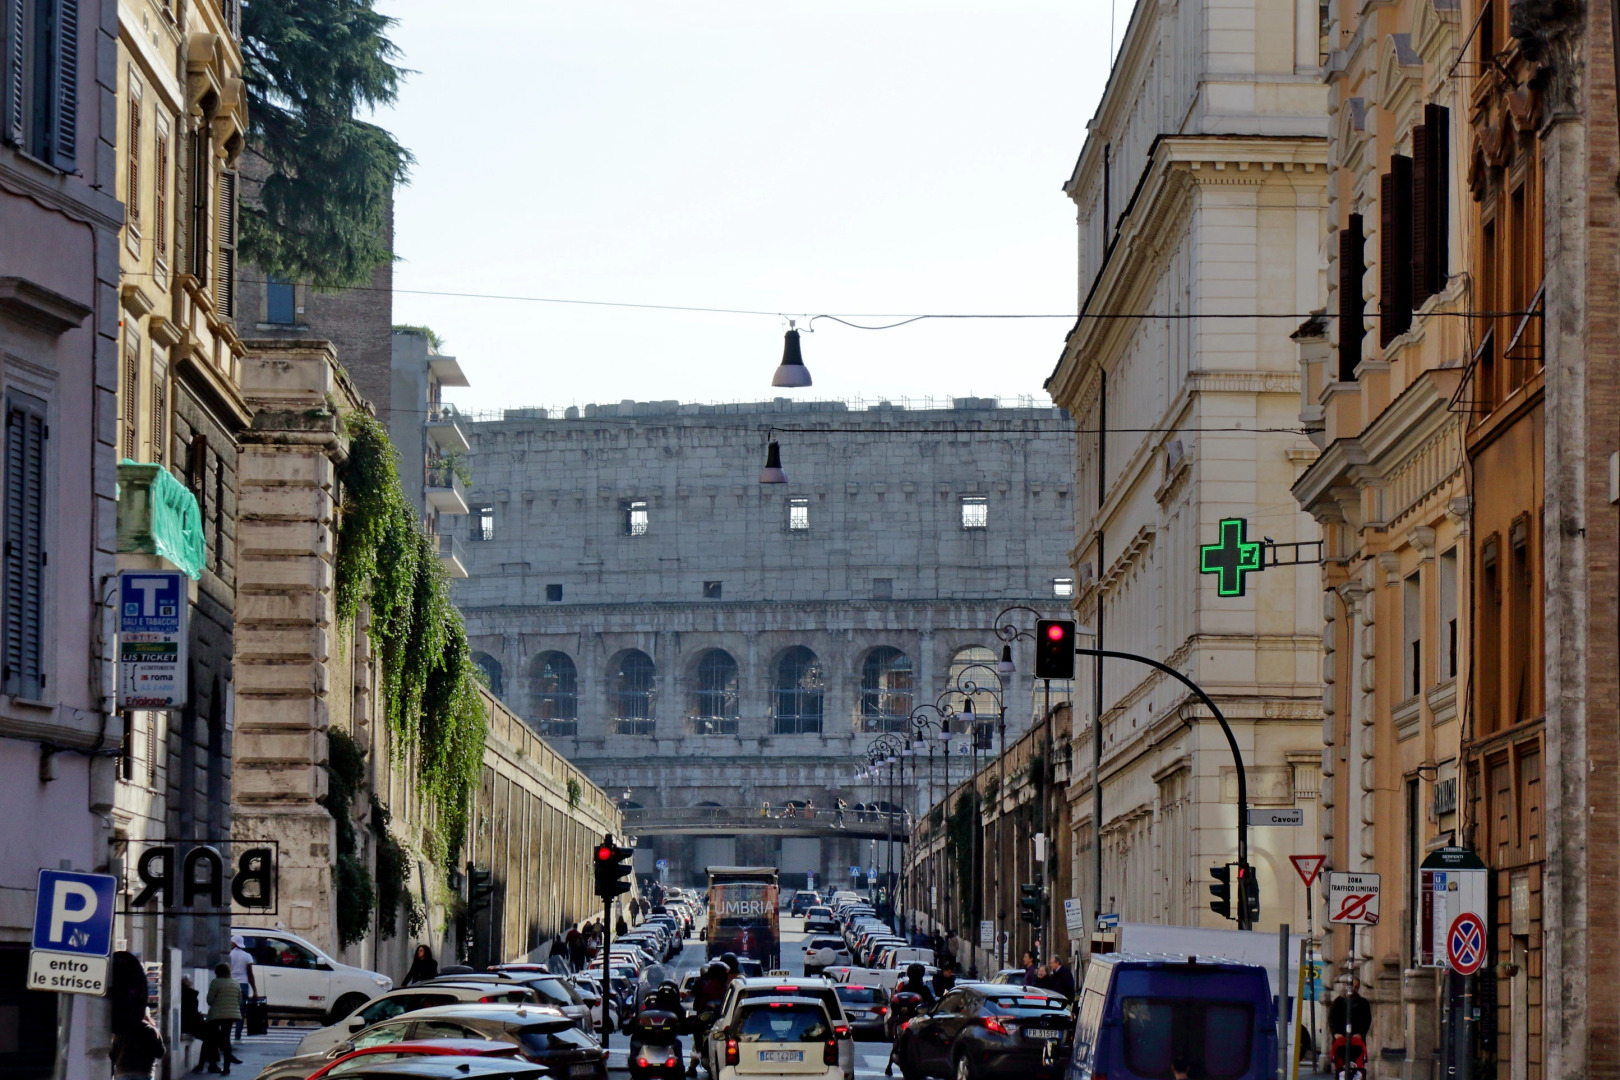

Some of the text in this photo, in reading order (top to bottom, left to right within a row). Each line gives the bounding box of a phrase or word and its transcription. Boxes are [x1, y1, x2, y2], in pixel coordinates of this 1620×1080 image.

[131, 579, 169, 616] T
[123, 618, 178, 626] SALI E TABACCHI
[1355, 885, 1379, 893] LIMITATO
[48, 880, 98, 943] P
[714, 901, 775, 915] UMBRIA
[50, 959, 89, 973] entro
[33, 971, 102, 991] le strisce
